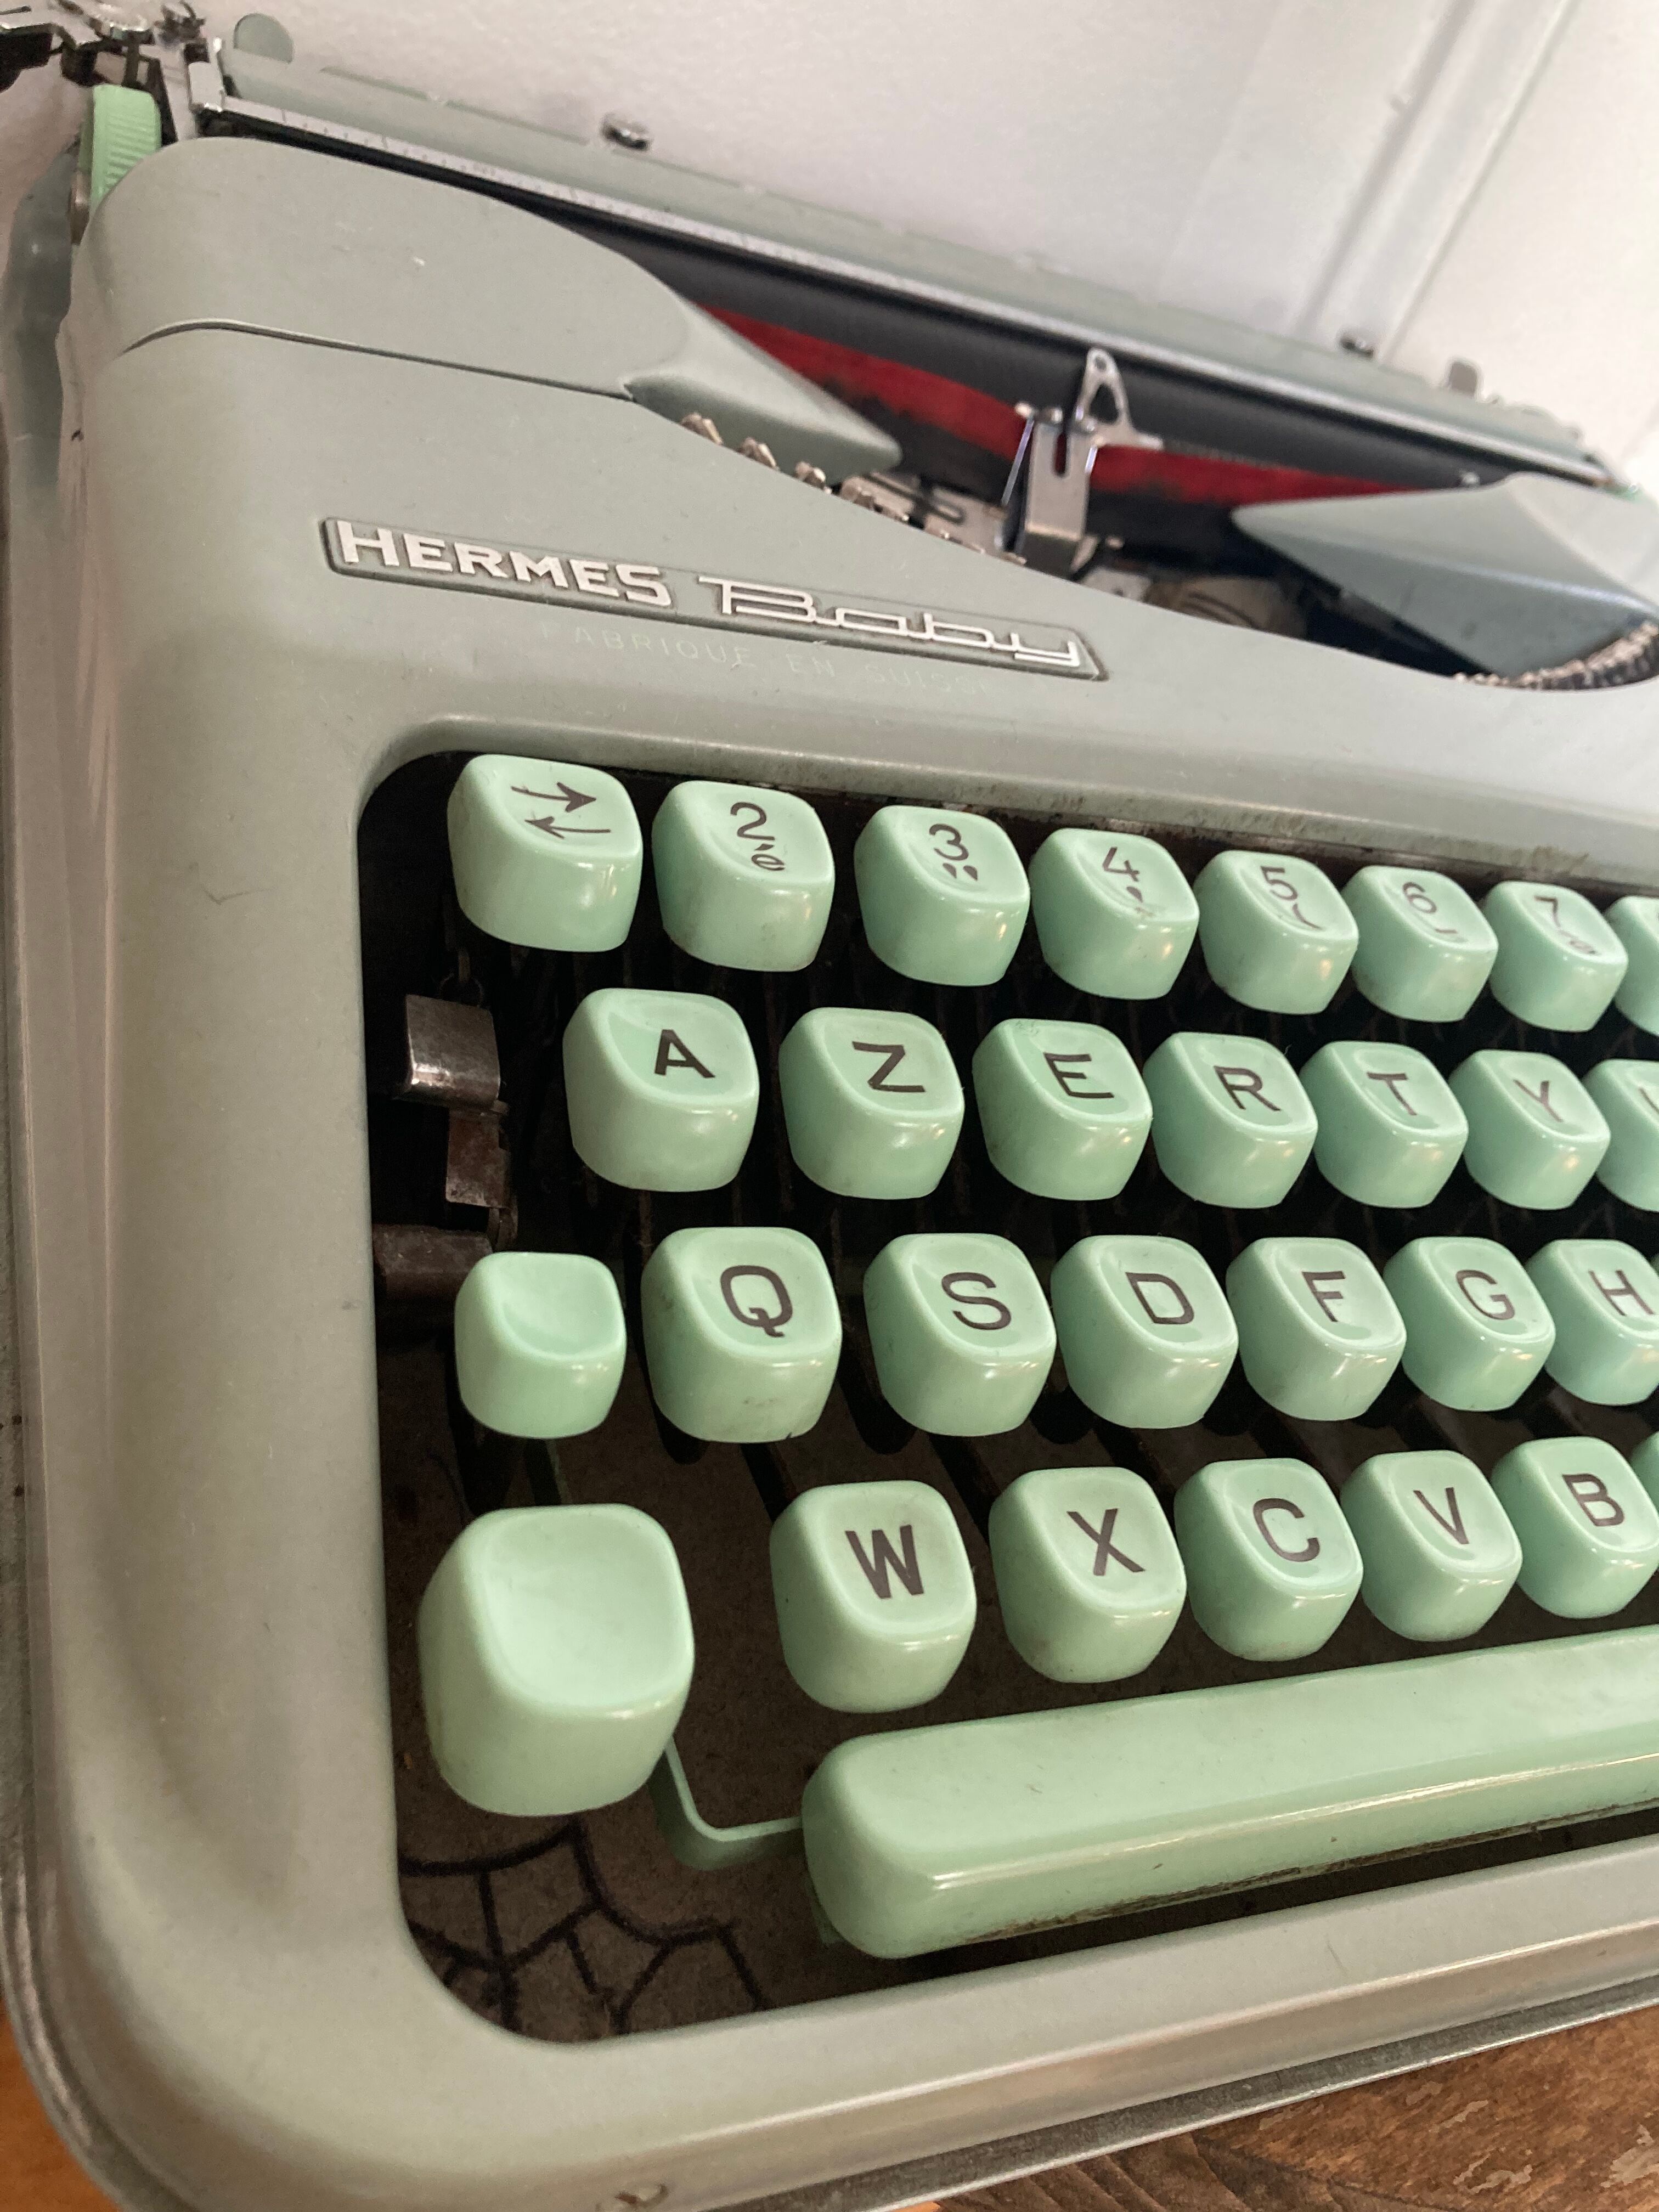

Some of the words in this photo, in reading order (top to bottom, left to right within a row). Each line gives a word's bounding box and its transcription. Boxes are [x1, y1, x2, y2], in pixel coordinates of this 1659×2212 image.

[336, 520, 672, 607] HERMES
[698, 575, 1081, 667] Baby
[730, 802, 775, 841] 2
[929, 823, 969, 861] 3
[1102, 847, 1141, 882] 4
[1260, 866, 1298, 901] 5
[1403, 882, 1437, 914] 6
[1534, 895, 1560, 928] 7
[654, 1029, 715, 1079] A
[852, 1041, 926, 1093] Z
[1044, 1053, 1115, 1099] E
[1214, 1066, 1281, 1111] R
[1367, 1071, 1417, 1116] T
[1513, 1080, 1563, 1122] Y
[720, 1265, 793, 1338] Q
[941, 1272, 1012, 1330] S
[1125, 1272, 1195, 1325] D
[1302, 1270, 1346, 1323] F
[1456, 1269, 1515, 1321] G
[1588, 1269, 1656, 1317] H
[1413, 1487, 1470, 1545] V
[1562, 1473, 1624, 1527] B
[1066, 1508, 1146, 1576] X
[1253, 1498, 1321, 1562] C
[845, 1523, 925, 1600] W
